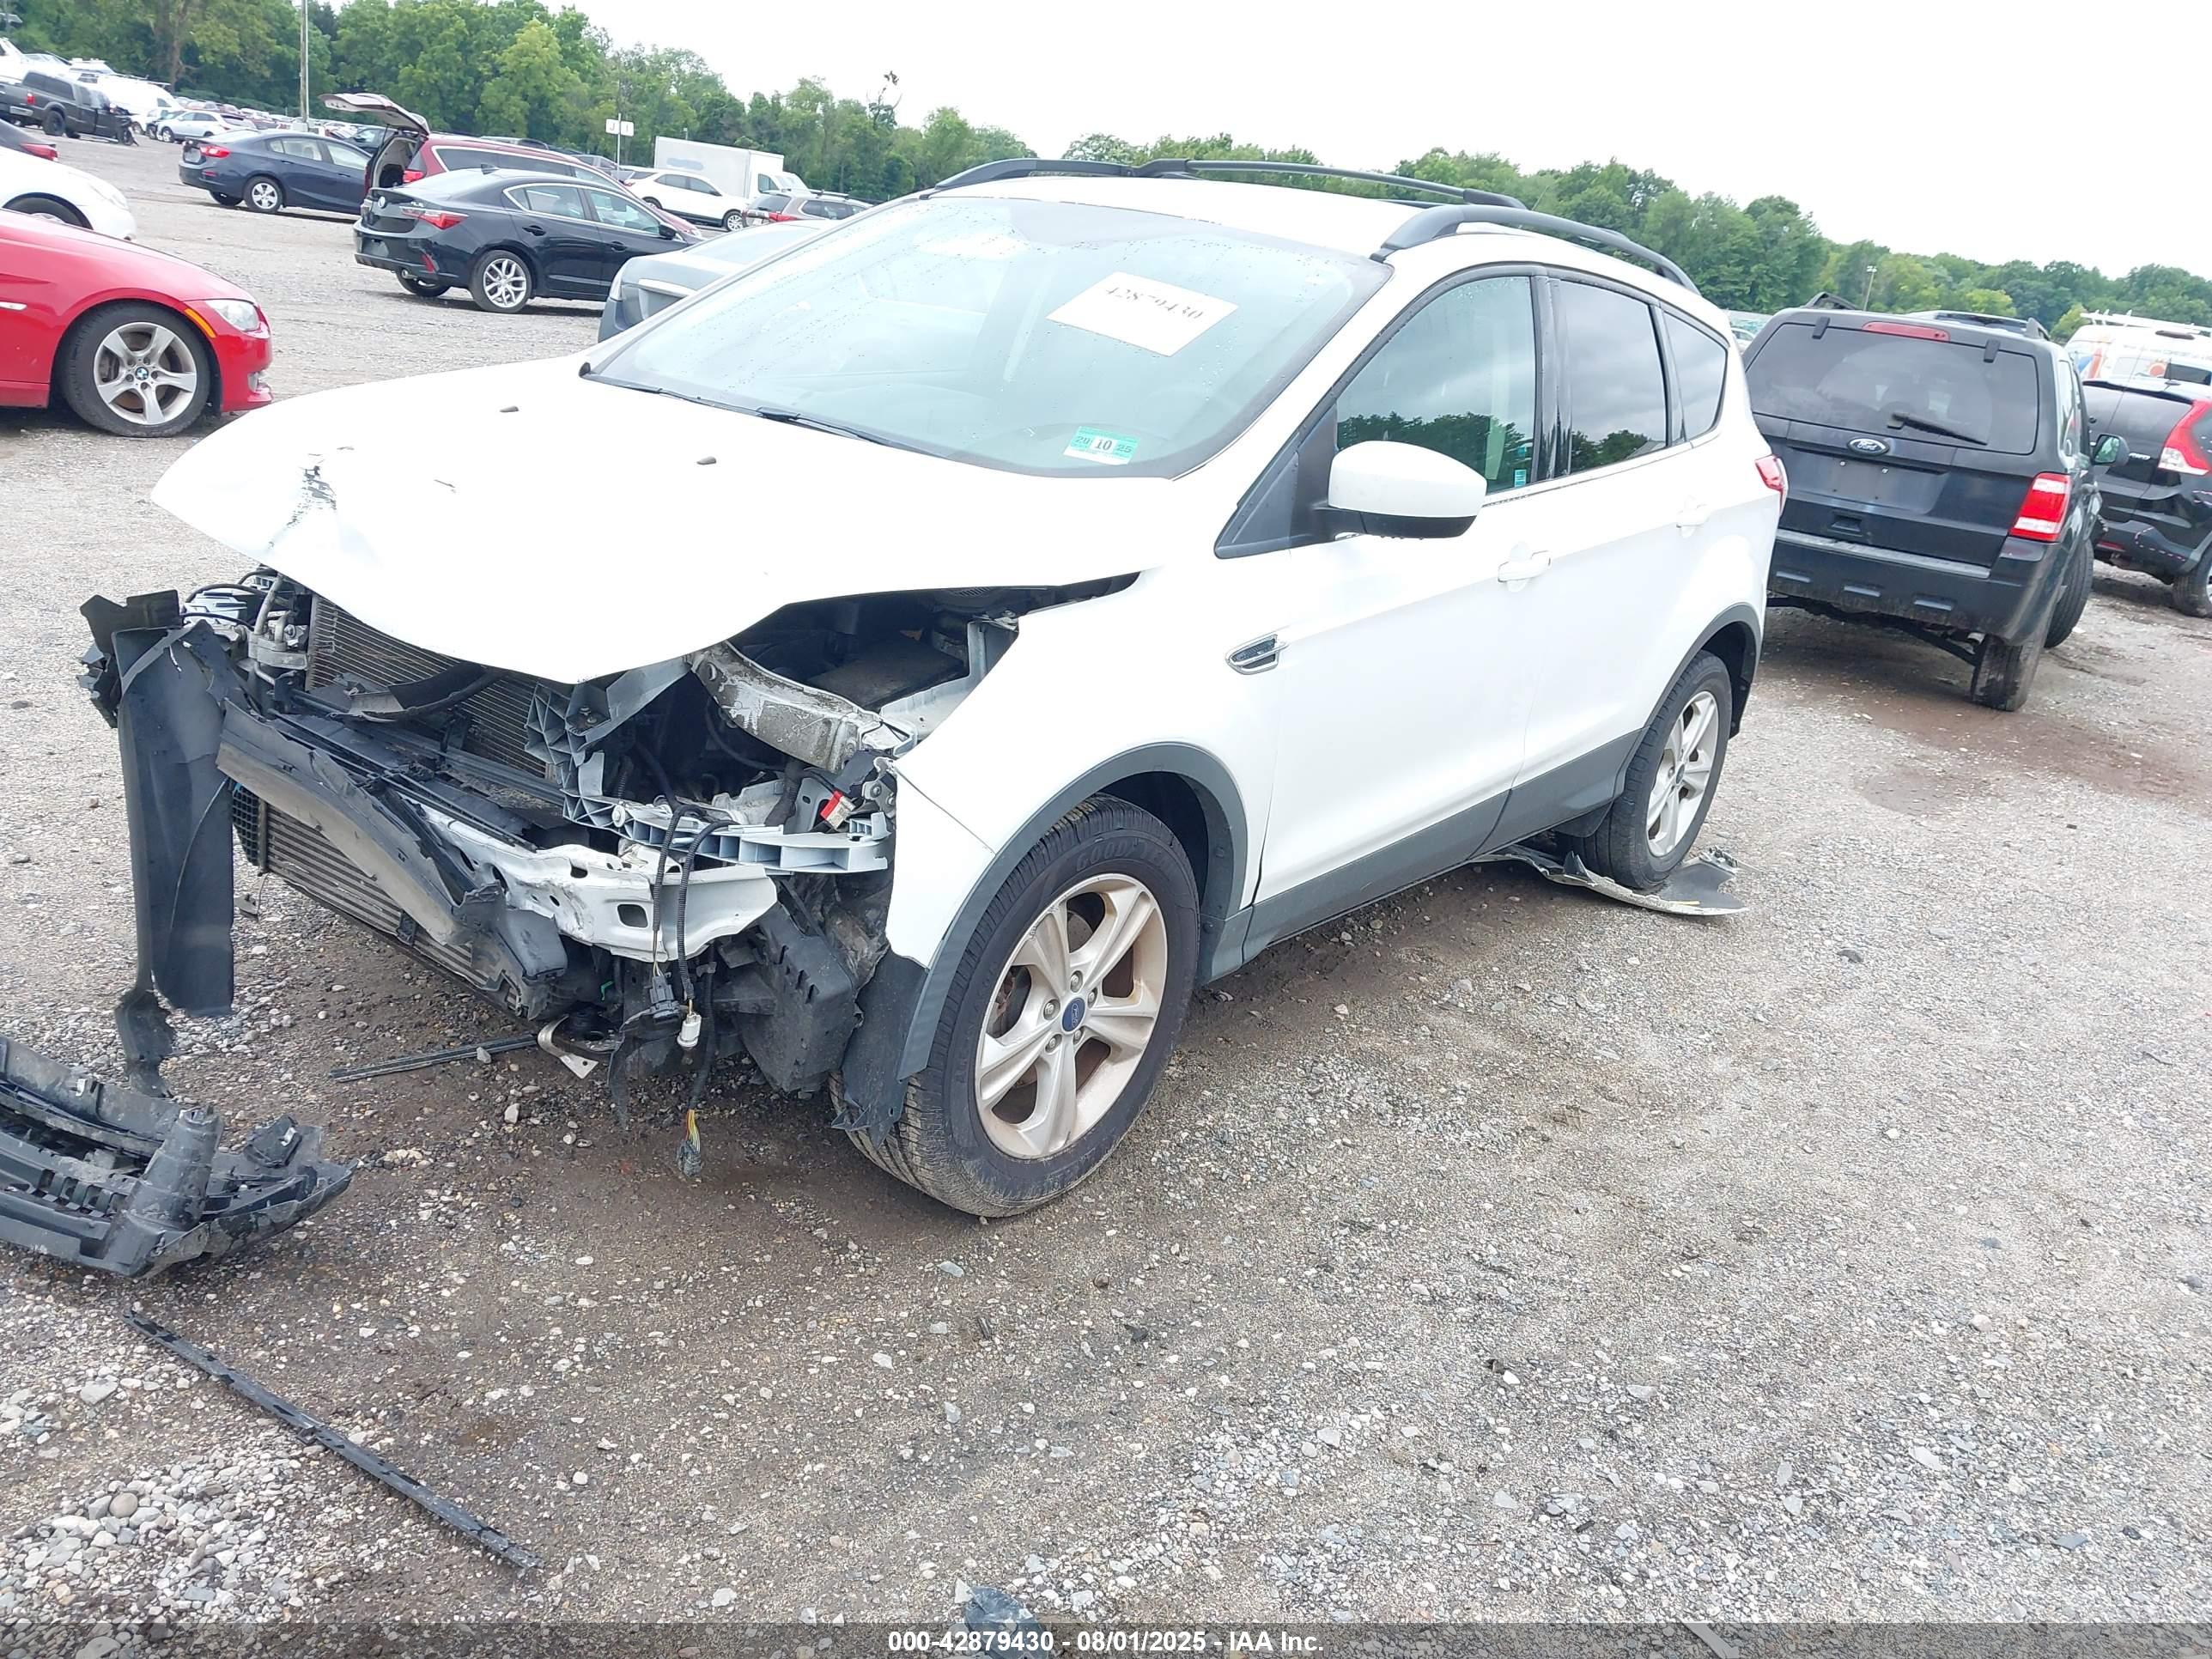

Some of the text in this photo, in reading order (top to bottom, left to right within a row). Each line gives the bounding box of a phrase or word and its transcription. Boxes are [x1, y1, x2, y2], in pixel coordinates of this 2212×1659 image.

[610, 123, 616, 131] J
[1075, 436, 1133, 454] 20 10 25
[1076, 840, 1173, 872] GOODY
